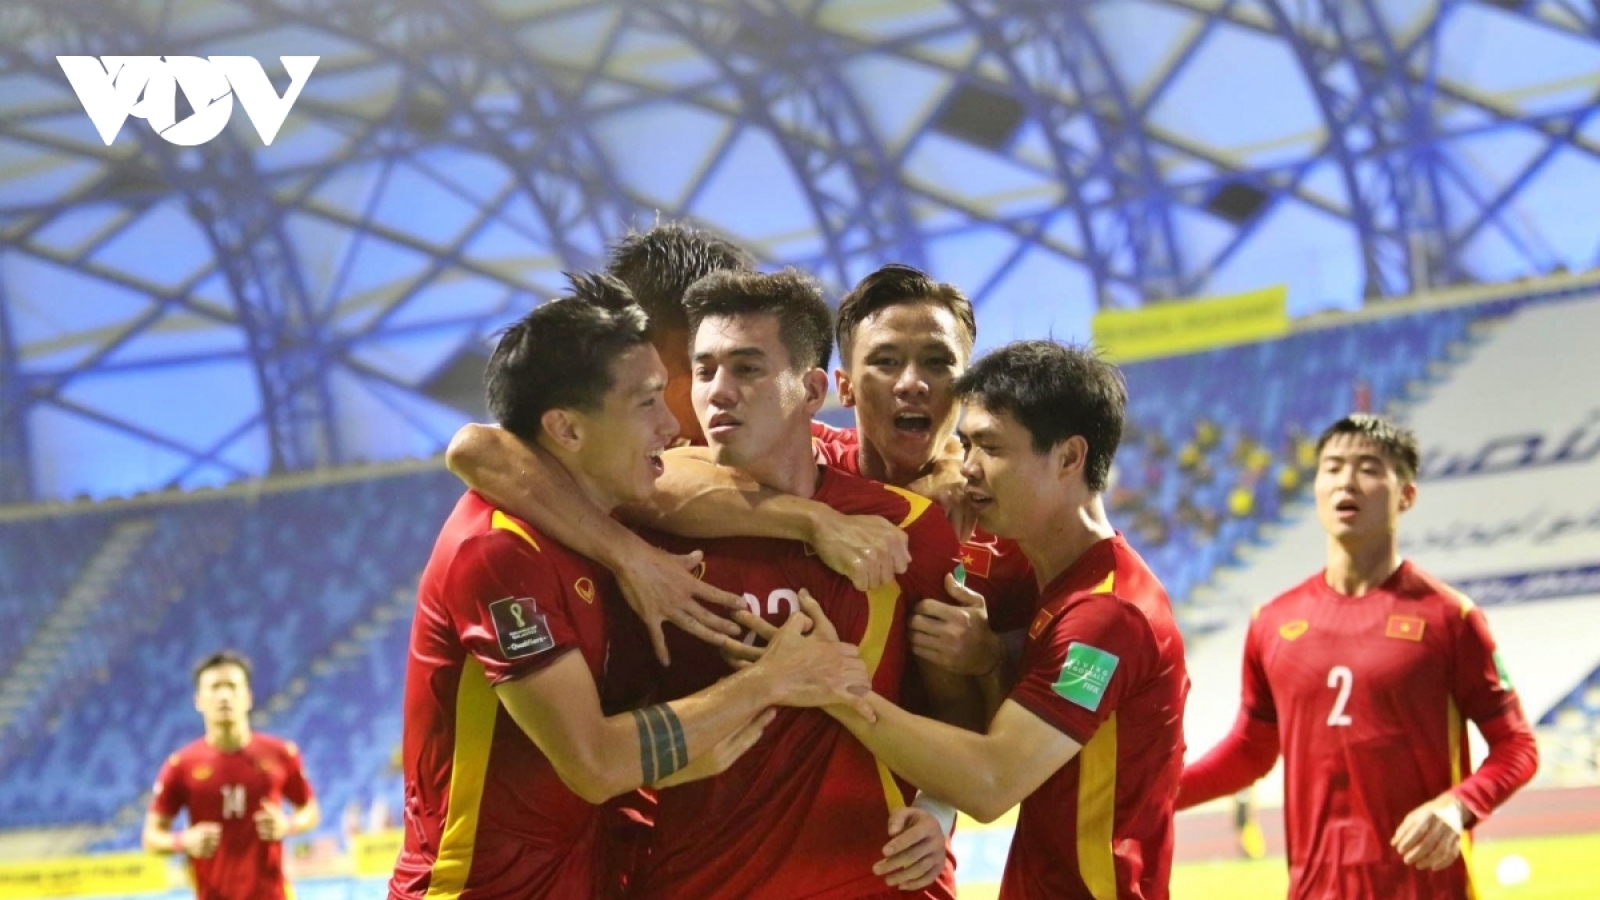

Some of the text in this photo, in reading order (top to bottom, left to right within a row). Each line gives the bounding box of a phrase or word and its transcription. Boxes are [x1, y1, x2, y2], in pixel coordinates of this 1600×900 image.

[1067, 659, 1109, 677] IVING
[1327, 666, 1353, 727] 2
[221, 785, 247, 819] 14
